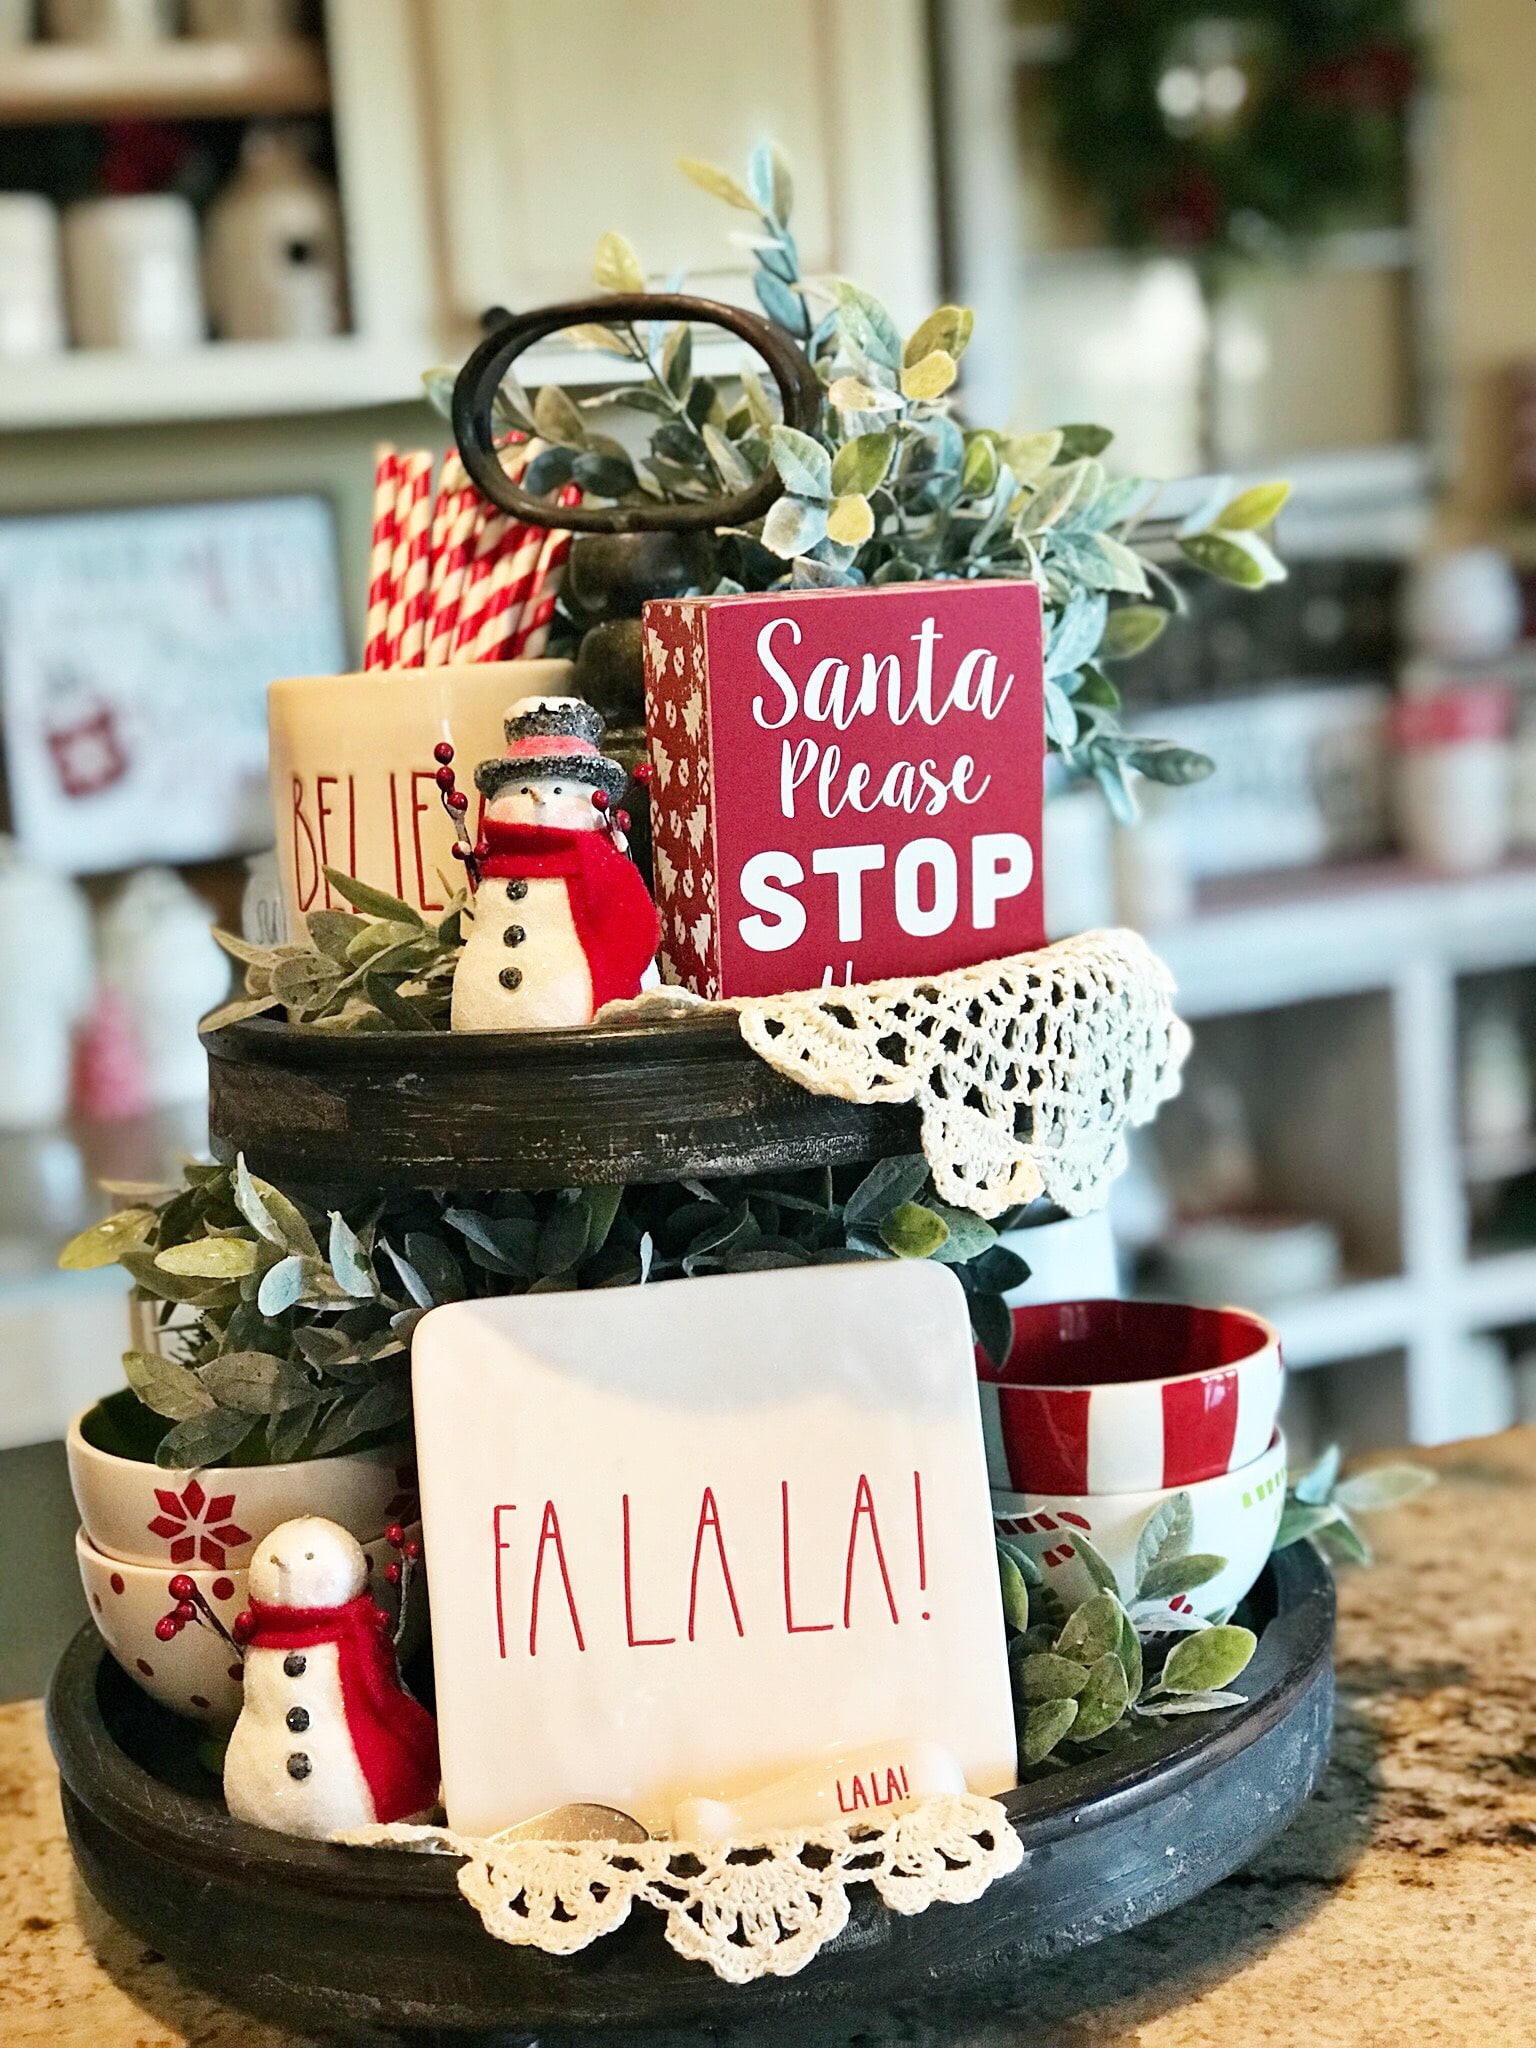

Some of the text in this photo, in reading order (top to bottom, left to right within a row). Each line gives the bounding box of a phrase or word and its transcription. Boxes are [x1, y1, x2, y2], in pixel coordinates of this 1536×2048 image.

[752, 617, 1015, 731] Santa
[780, 738, 992, 820] Please
[738, 832, 1034, 953] STOP
[493, 1470, 931, 1660] FA LA LA!
